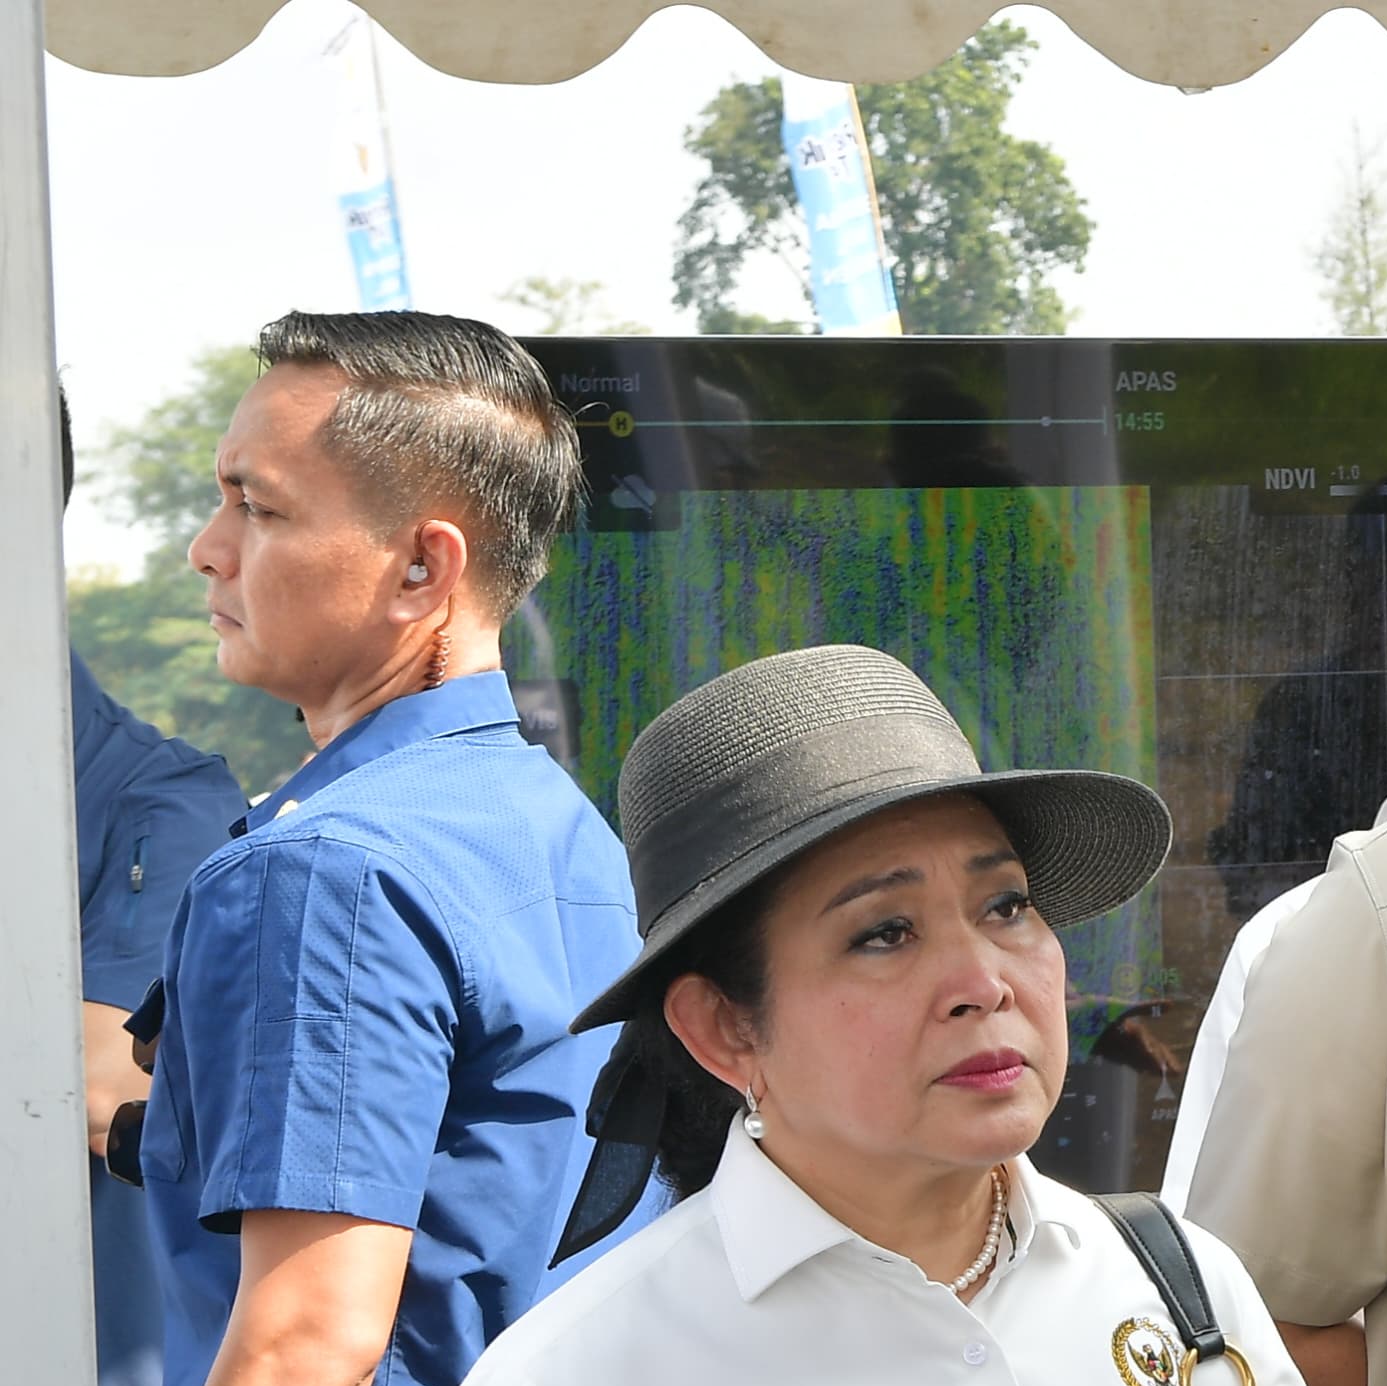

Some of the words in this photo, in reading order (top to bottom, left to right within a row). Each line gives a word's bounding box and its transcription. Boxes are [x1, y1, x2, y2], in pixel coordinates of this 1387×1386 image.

[560, 373, 641, 393] Normal
[1115, 371, 1177, 392] APAS
[1115, 412, 1165, 431] 14:55
[1264, 468, 1316, 490] NDVI
[1330, 465, 1361, 481] -1.0
